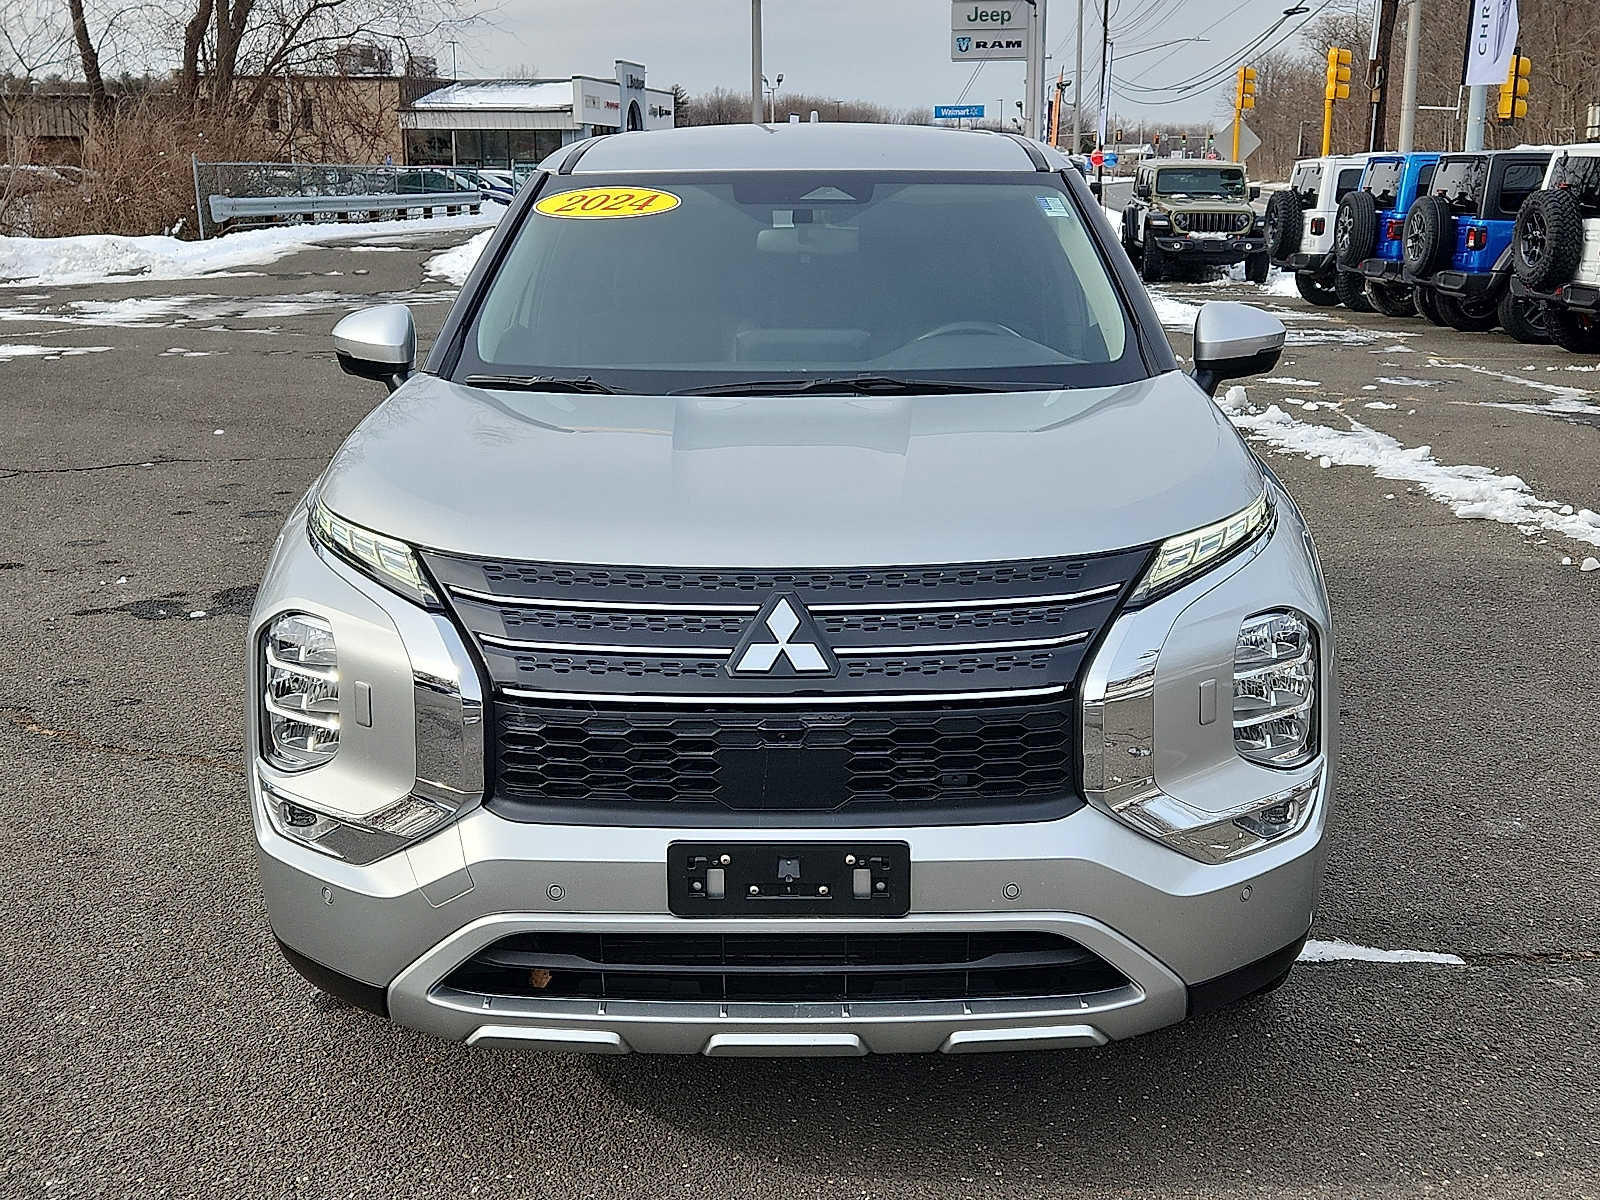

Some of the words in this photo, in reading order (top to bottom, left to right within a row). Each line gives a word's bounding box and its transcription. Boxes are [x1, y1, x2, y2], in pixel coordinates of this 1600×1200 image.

[967, 6, 1012, 25] Jeep
[1478, 0, 1491, 56] CHR
[975, 40, 1022, 49] RAM
[553, 193, 660, 212] 2024
